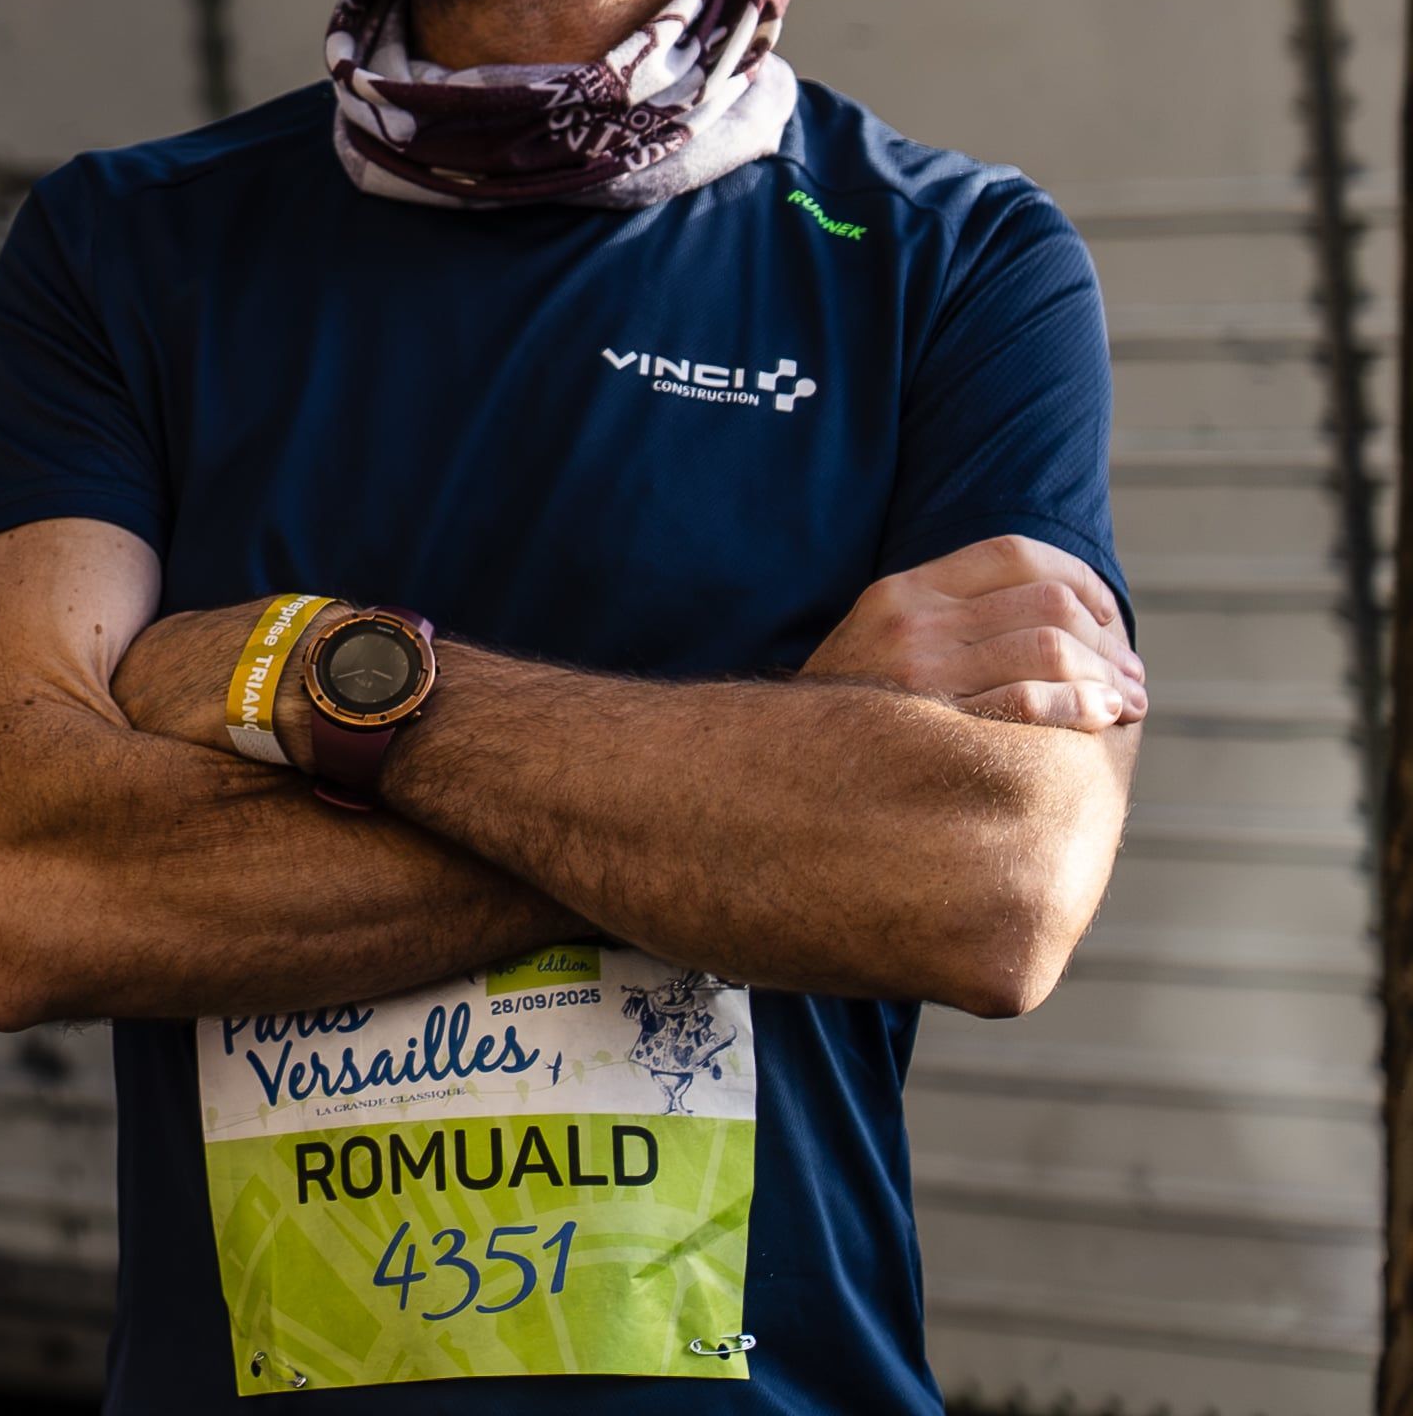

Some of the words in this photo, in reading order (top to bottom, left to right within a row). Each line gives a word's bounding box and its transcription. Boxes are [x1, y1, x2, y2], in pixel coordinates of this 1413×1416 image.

[601, 347, 745, 390] VINCI
[653, 379, 760, 407] CONSTRUCTION
[490, 988, 601, 1016] 28/09/2025
[247, 1001, 540, 1107] Versailles
[316, 1107, 332, 1117] LA
[334, 1097, 388, 1114] GRANDE
[390, 1086, 467, 1105] CLASSIQUE
[295, 1125, 660, 1205] ROMUALD
[373, 1220, 578, 1321] 4351
